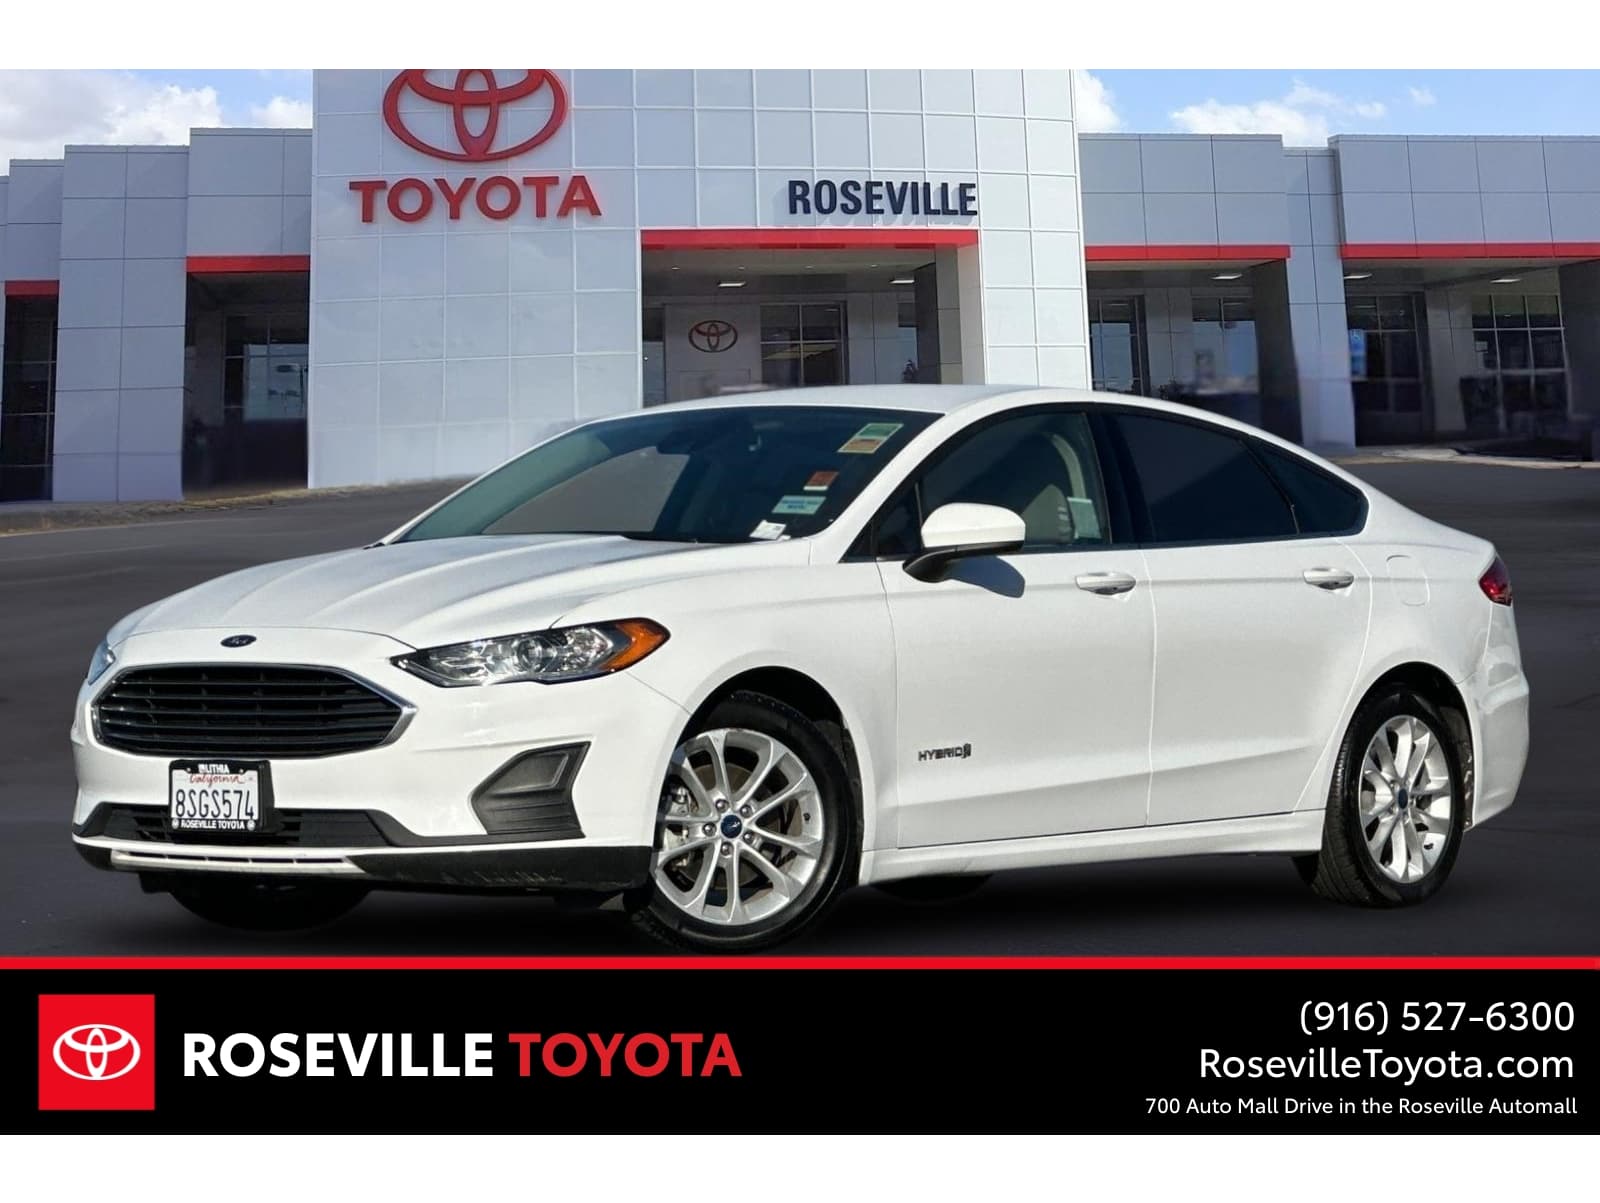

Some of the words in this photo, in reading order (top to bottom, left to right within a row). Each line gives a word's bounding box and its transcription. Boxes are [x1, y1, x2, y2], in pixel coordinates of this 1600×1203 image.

[349, 175, 602, 223] TOYOTA
[788, 179, 978, 216] ROSEVILLE
[175, 788, 254, 820] 8SGS574
[181, 820, 217, 829] ROSEVILLE
[219, 820, 245, 829] TOYOTA
